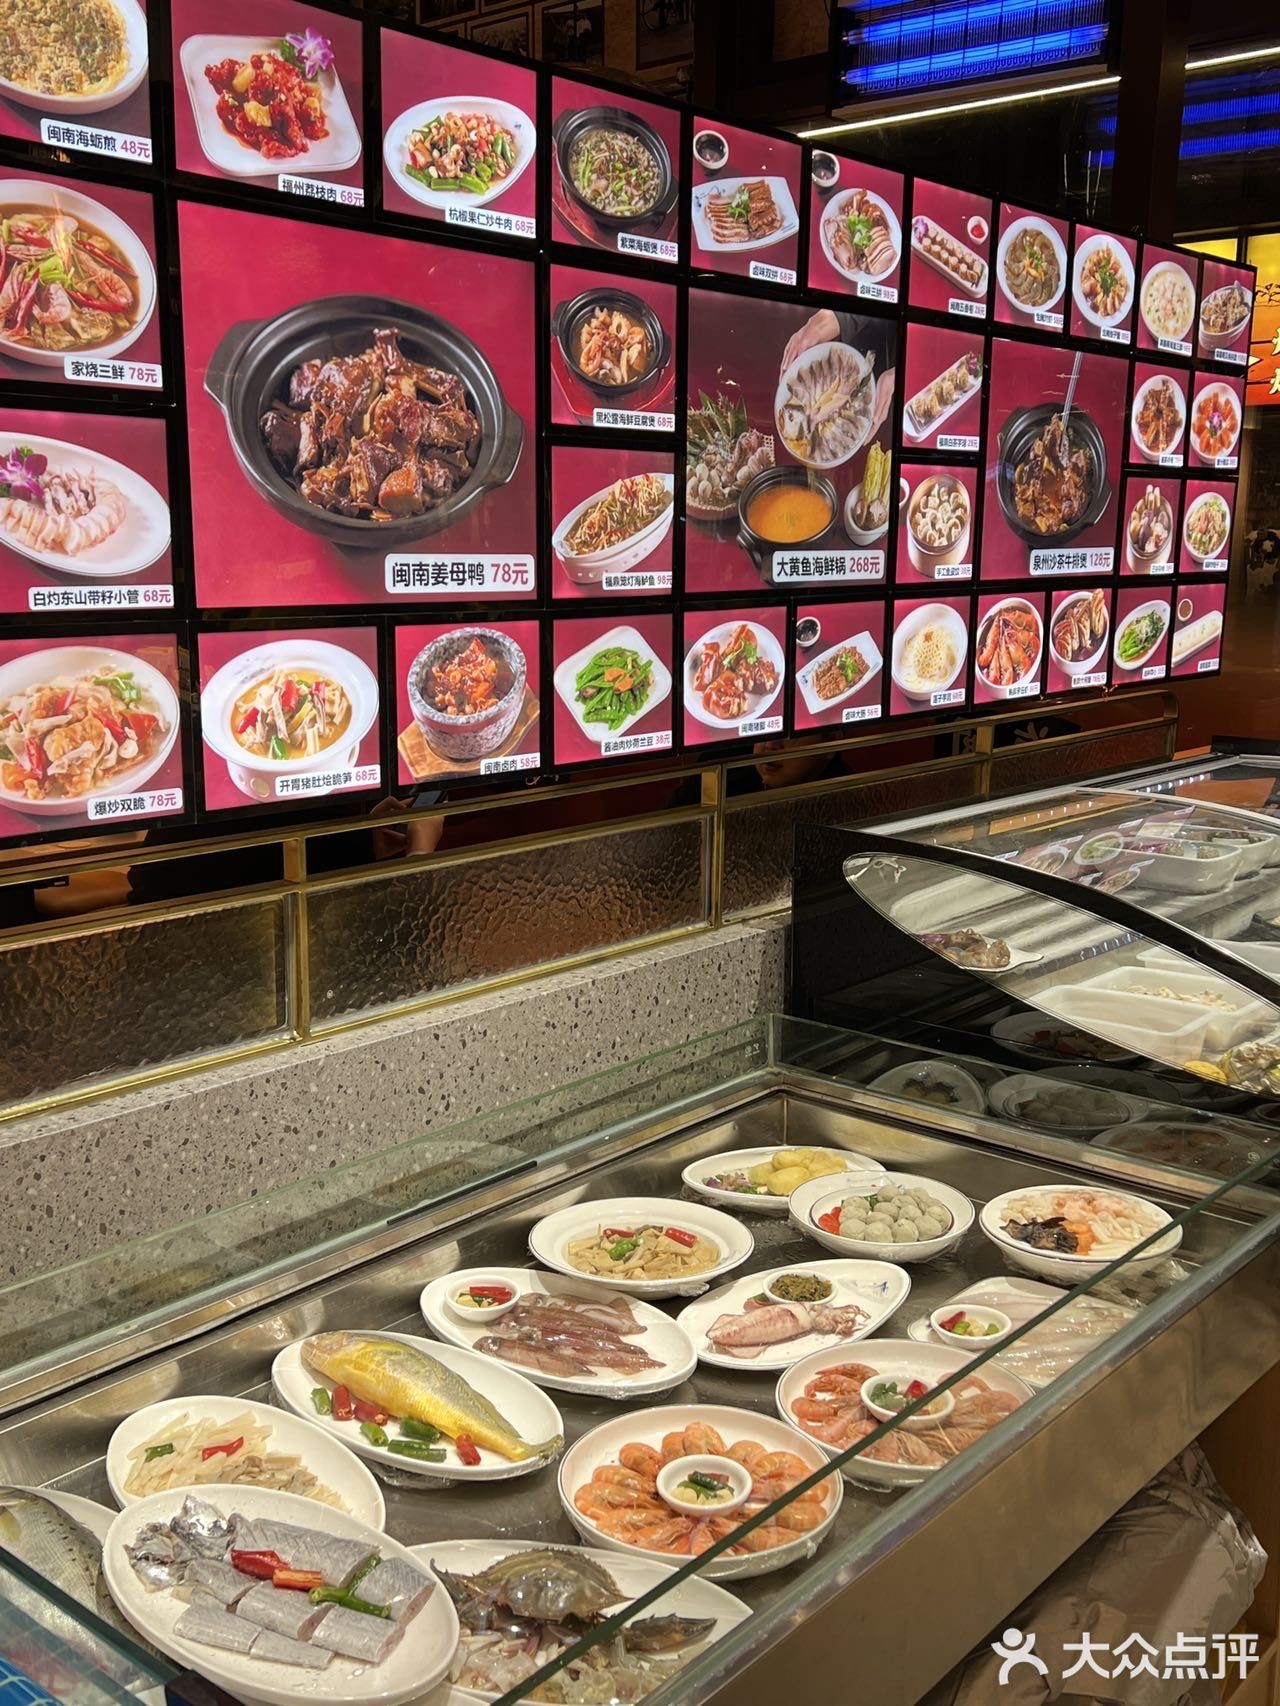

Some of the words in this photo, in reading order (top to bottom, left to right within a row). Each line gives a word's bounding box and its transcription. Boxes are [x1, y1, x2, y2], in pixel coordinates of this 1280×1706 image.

[47, 124, 117, 152] 闽南海蛎煎
[121, 139, 151, 159] 48元
[282, 178, 337, 202] 福州荔枝肉
[341, 192, 364, 207] 68元
[448, 207, 513, 231] 杭椒果仁炒牛肉
[515, 220, 535, 235] 68元
[620, 236, 658, 255] 紫菜海蛎煲
[660, 244, 677, 258] 68元
[71, 361, 125, 380] 家烧三鲜
[128, 367, 158, 383] 78元
[596, 411, 656, 428] 黑松露海鲜豆腐煲
[657, 417, 674, 428] 68元
[777, 556, 847, 577] 大黄鱼海鲜锅
[849, 556, 881, 575] 268元
[1033, 553, 1088, 571] 泉州沙茶牛排煲
[1089, 552, 1111, 568] 128元
[392, 562, 486, 588] 闽南姜母鸭
[490, 562, 529, 586] 78元
[657, 574, 673, 586] 98元
[33, 589, 140, 606] 白灼东山带籽小管
[143, 588, 172, 603] 68元
[655, 734, 671, 746] 38元
[484, 760, 518, 774] 闽南卤肉
[520, 755, 538, 768] 58元
[279, 772, 353, 794] 开胃猪肚烩脆笋
[354, 769, 378, 783] 68元
[94, 796, 146, 816] 爆炒双脆
[148, 793, 177, 808] 78元
